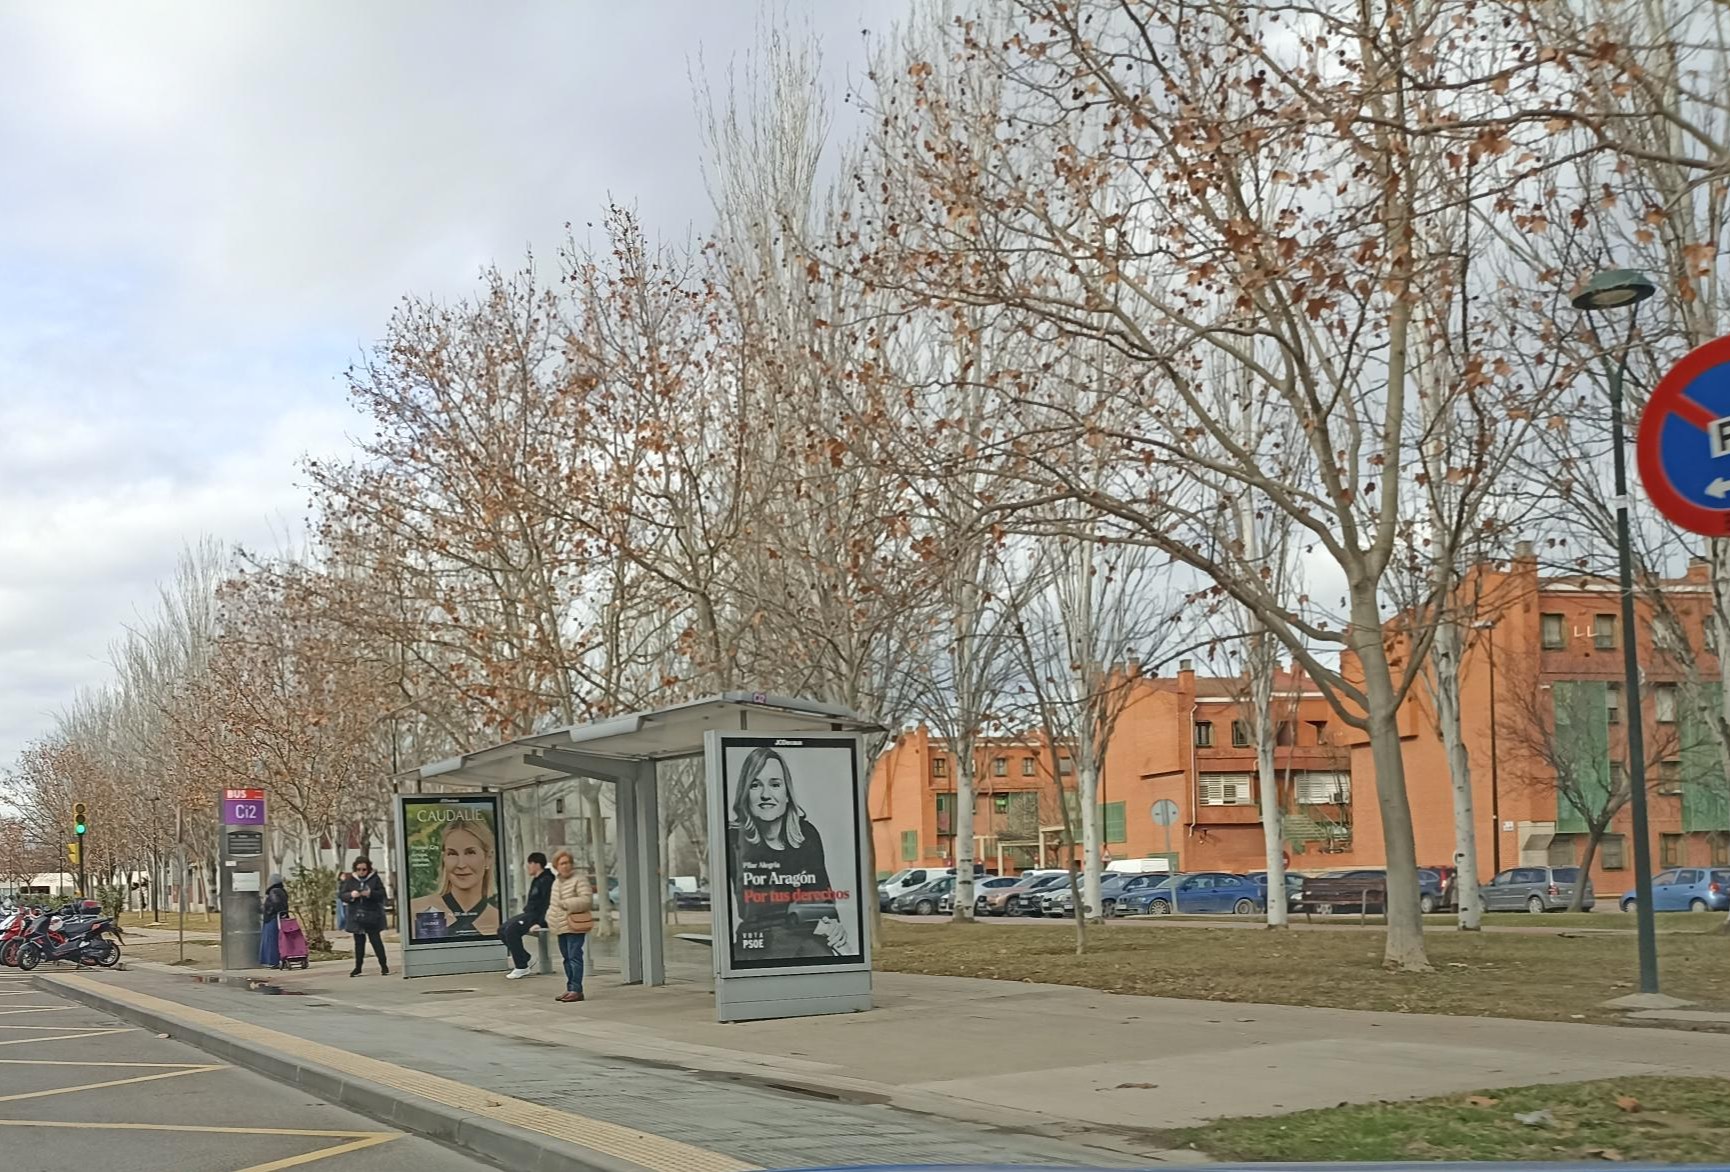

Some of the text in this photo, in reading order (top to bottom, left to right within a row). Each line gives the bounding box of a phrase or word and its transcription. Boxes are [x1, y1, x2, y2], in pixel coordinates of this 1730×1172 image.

[226, 789, 247, 799] BUS
[235, 804, 257, 819] Ci2
[416, 809, 485, 822] CAUDALIE
[743, 870, 816, 888] Por Aragón
[743, 887, 850, 903] Por tus derechos
[742, 939, 764, 949] PSOE
